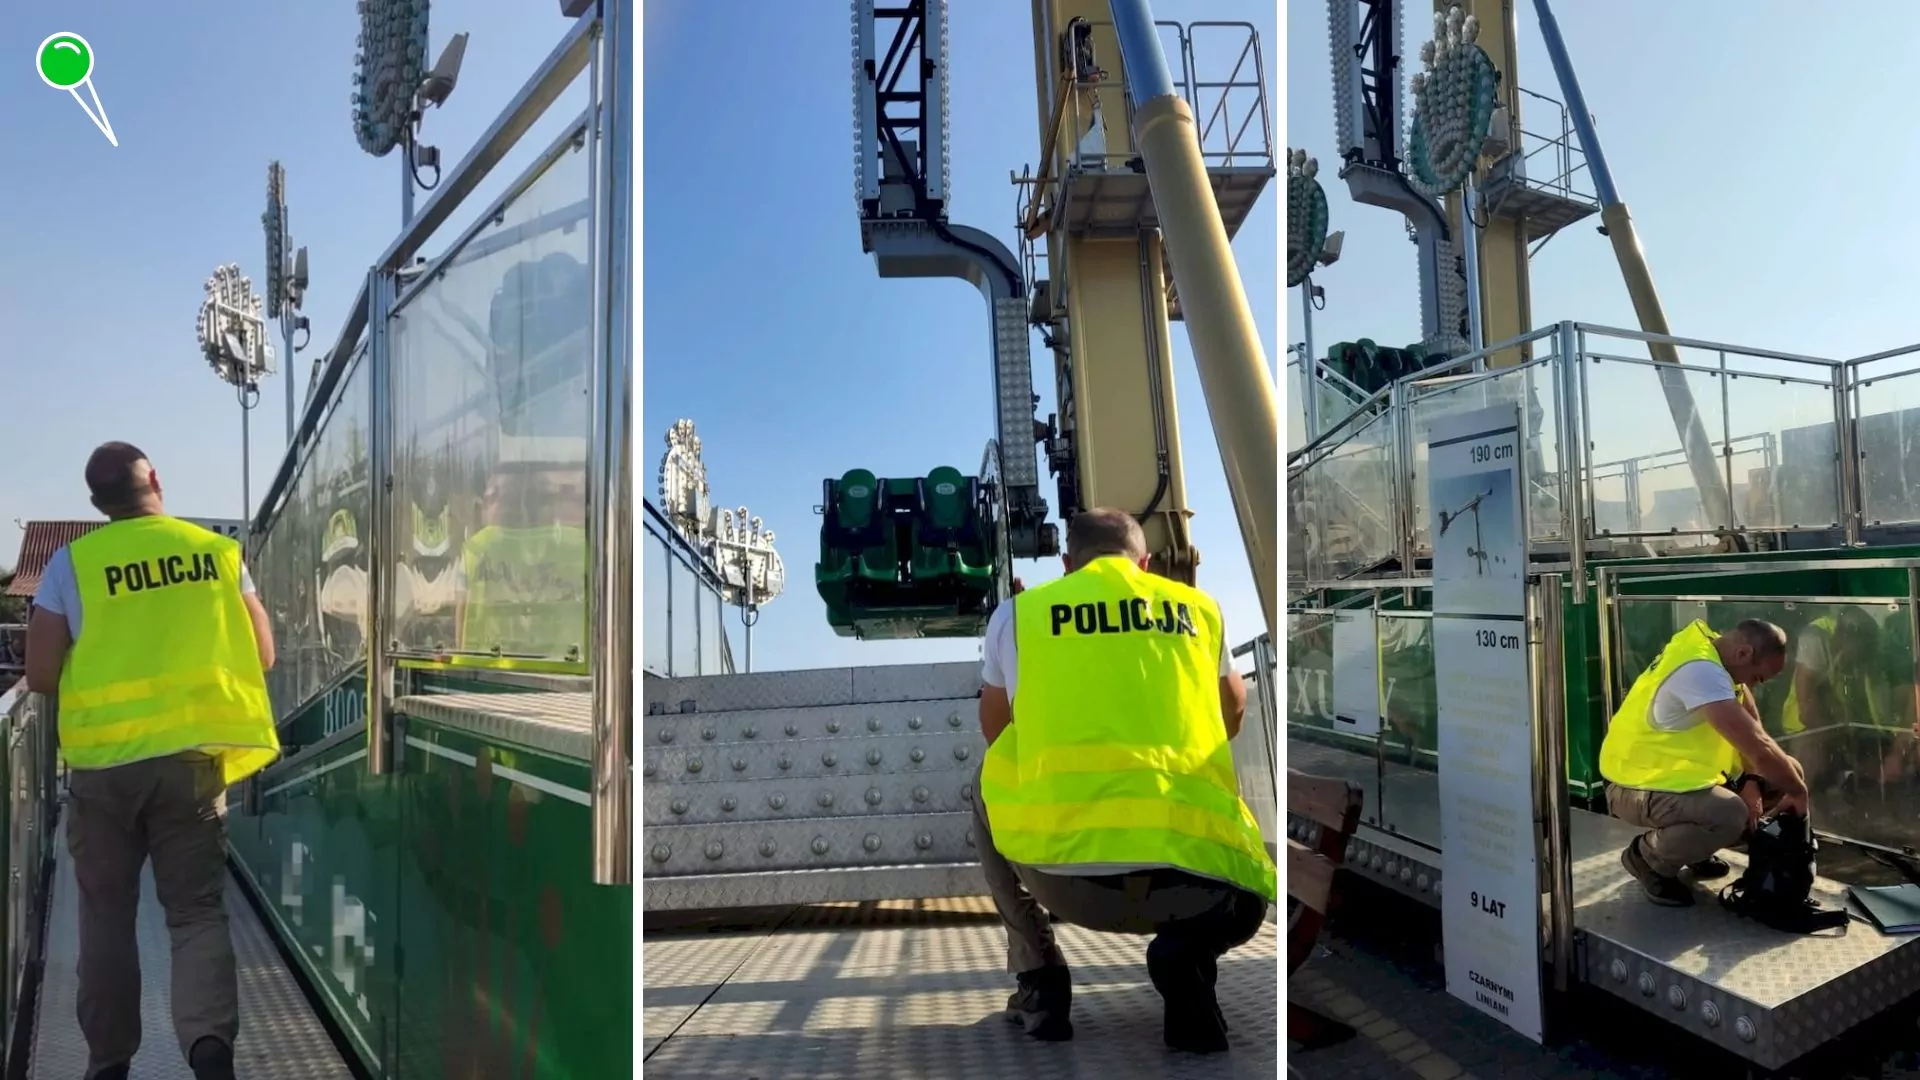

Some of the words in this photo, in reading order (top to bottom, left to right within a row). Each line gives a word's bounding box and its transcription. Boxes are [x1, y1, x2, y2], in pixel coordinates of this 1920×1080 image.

[1470, 445, 1491, 464] 190
[1494, 444, 1513, 459] cm
[104, 553, 220, 596] POLICJA
[1051, 598, 1197, 637] POLICJA
[1475, 630, 1497, 648] 130
[1500, 633, 1519, 650] cm
[1471, 891, 1478, 908] 9
[1482, 895, 1506, 919] LAT
[1468, 970, 1514, 1002] CZARNYMI
[1476, 991, 1509, 1017] LINIAMI
